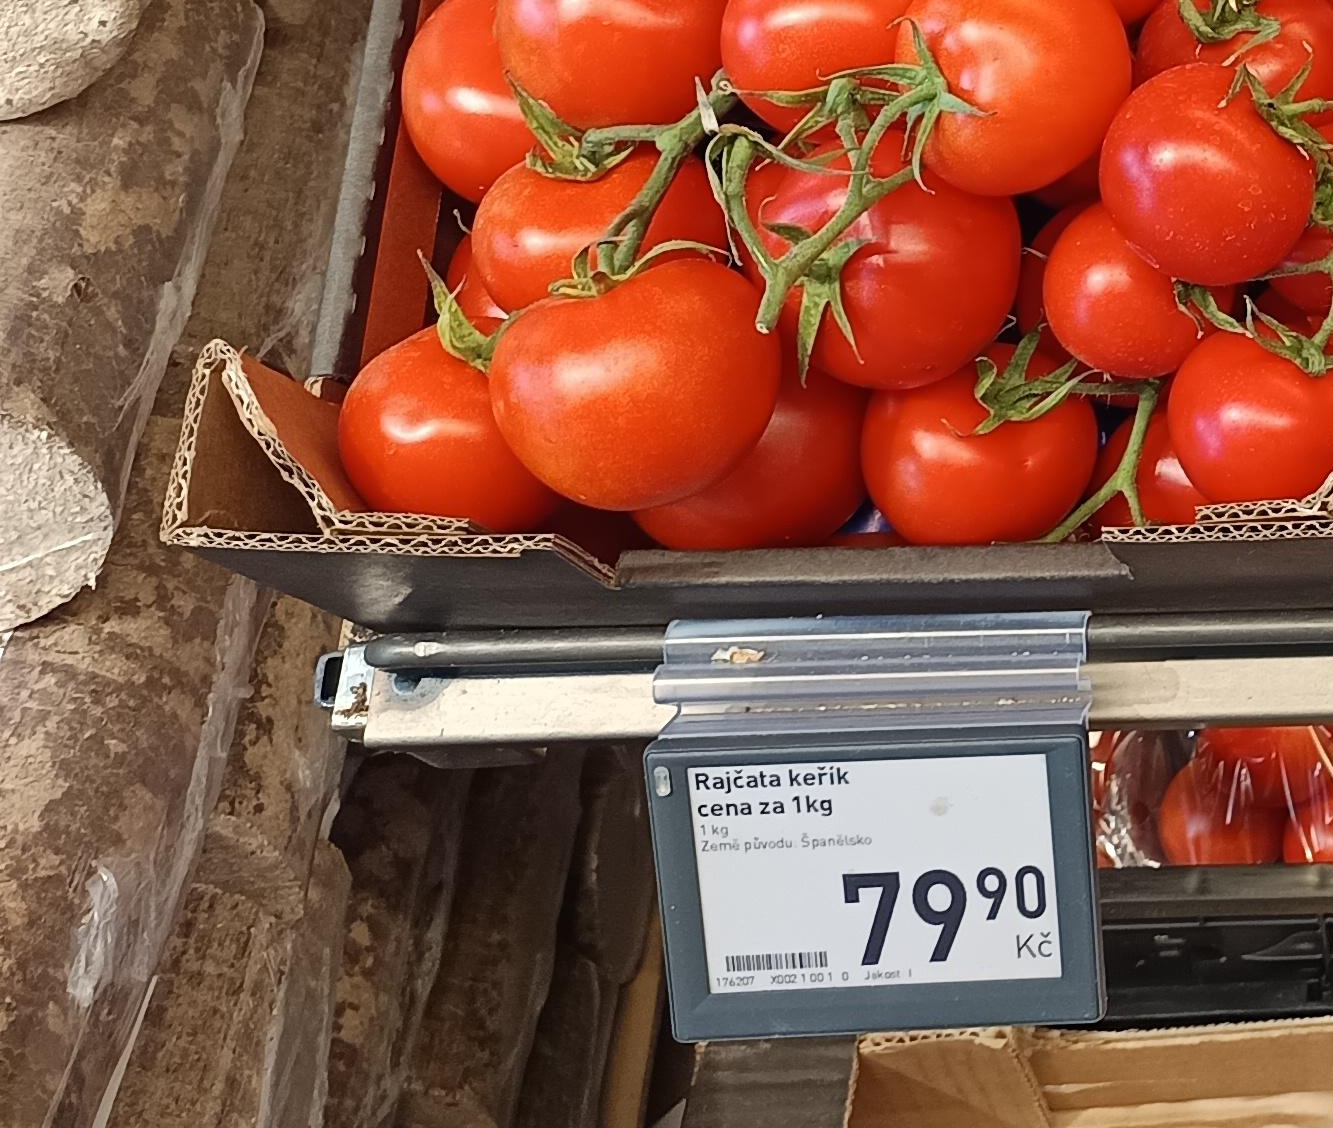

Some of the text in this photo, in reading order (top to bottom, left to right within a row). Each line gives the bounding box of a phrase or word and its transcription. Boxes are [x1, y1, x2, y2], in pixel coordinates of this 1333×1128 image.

[695, 765, 850, 794] Rajčata keřík
[697, 801, 752, 817] cena
[759, 799, 785, 815] za
[700, 823, 729, 839] 1 kg
[701, 838, 740, 852] Země
[800, 833, 873, 850] Španělsko
[841, 864, 1047, 967] 79 90
[1015, 930, 1054, 959] Kč
[716, 975, 755, 988] 176207
